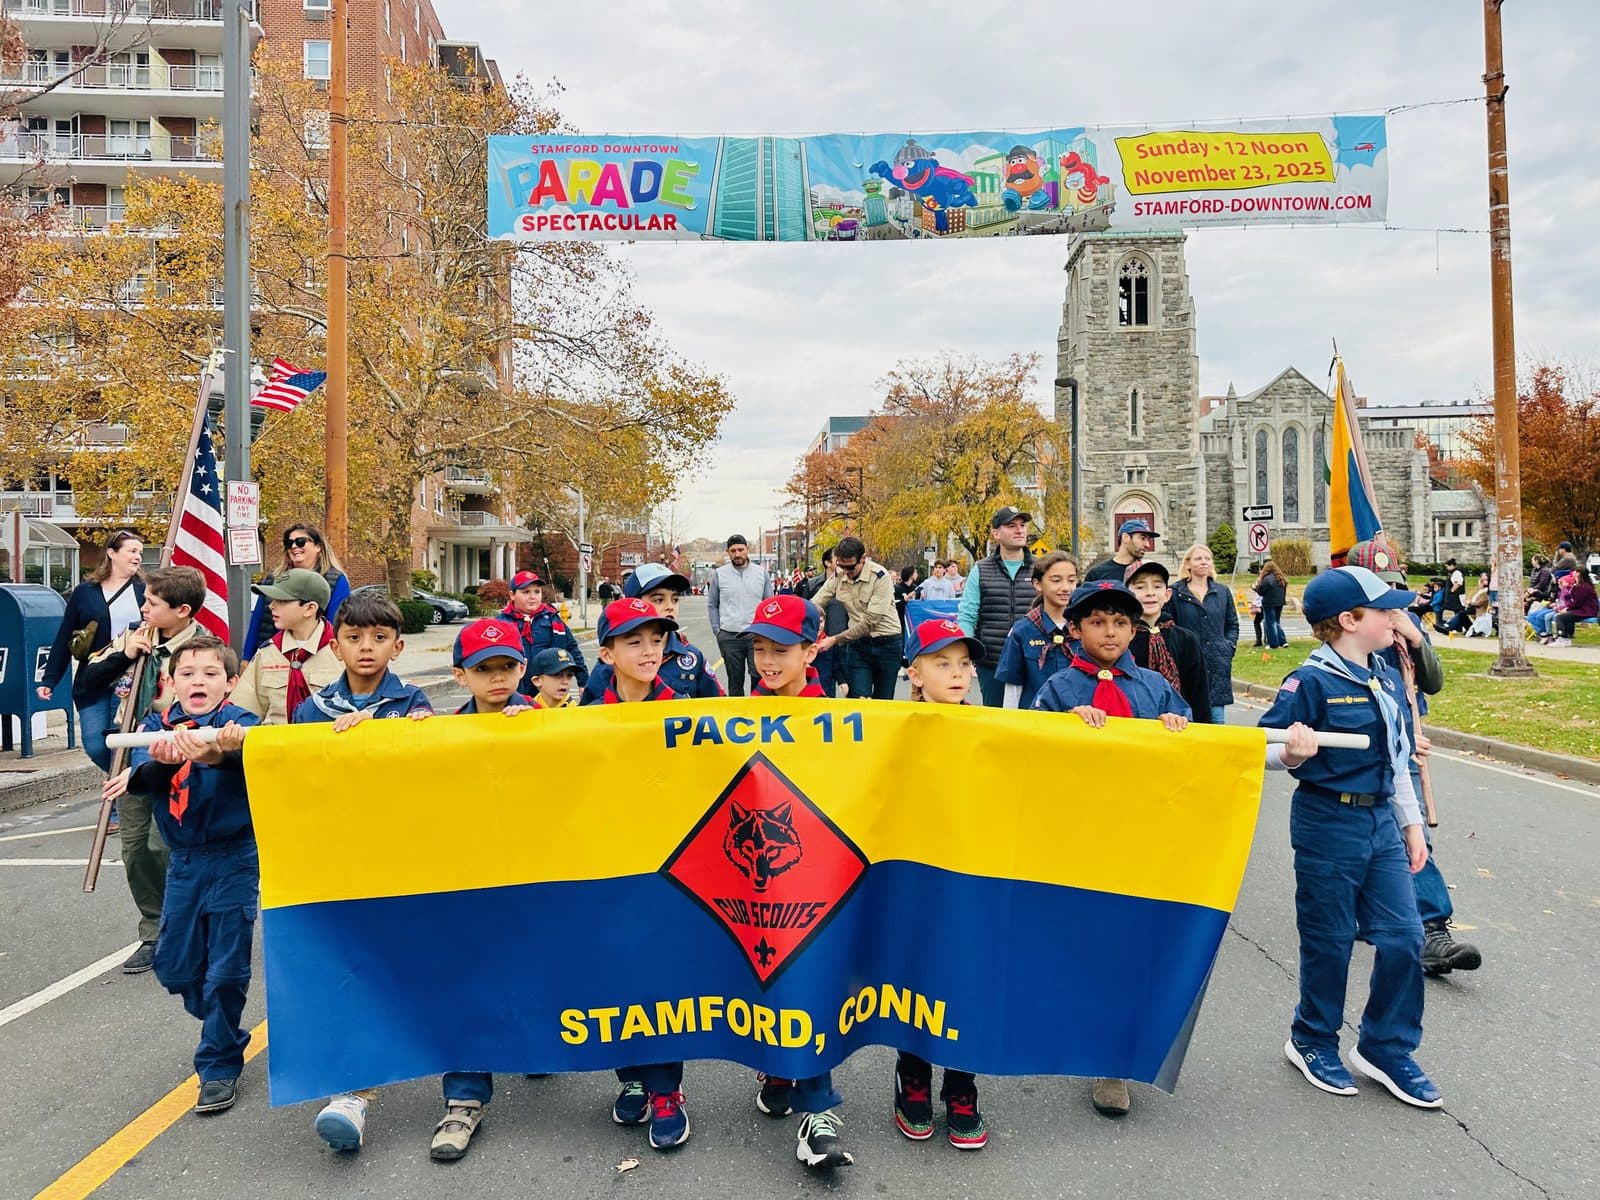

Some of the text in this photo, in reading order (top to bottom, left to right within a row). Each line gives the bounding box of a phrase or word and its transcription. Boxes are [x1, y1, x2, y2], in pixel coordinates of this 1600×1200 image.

[531, 144, 679, 154] STAMFORD DOWNTOWN
[1135, 139, 1309, 159] Sunday 12 Noon
[503, 158, 700, 210] PARADE
[1134, 161, 1326, 187] November 23, 2025
[1134, 194, 1372, 216] STAMFORD-DOWNTOWN.COM
[522, 213, 677, 232] SPECTACULAR
[230, 496, 256, 505] PARKING
[237, 486, 249, 495] NO
[664, 712, 864, 749] PACK 11
[713, 898, 827, 929] CUB SCOUTS
[559, 983, 960, 1055] STAMFORD, CONN.
